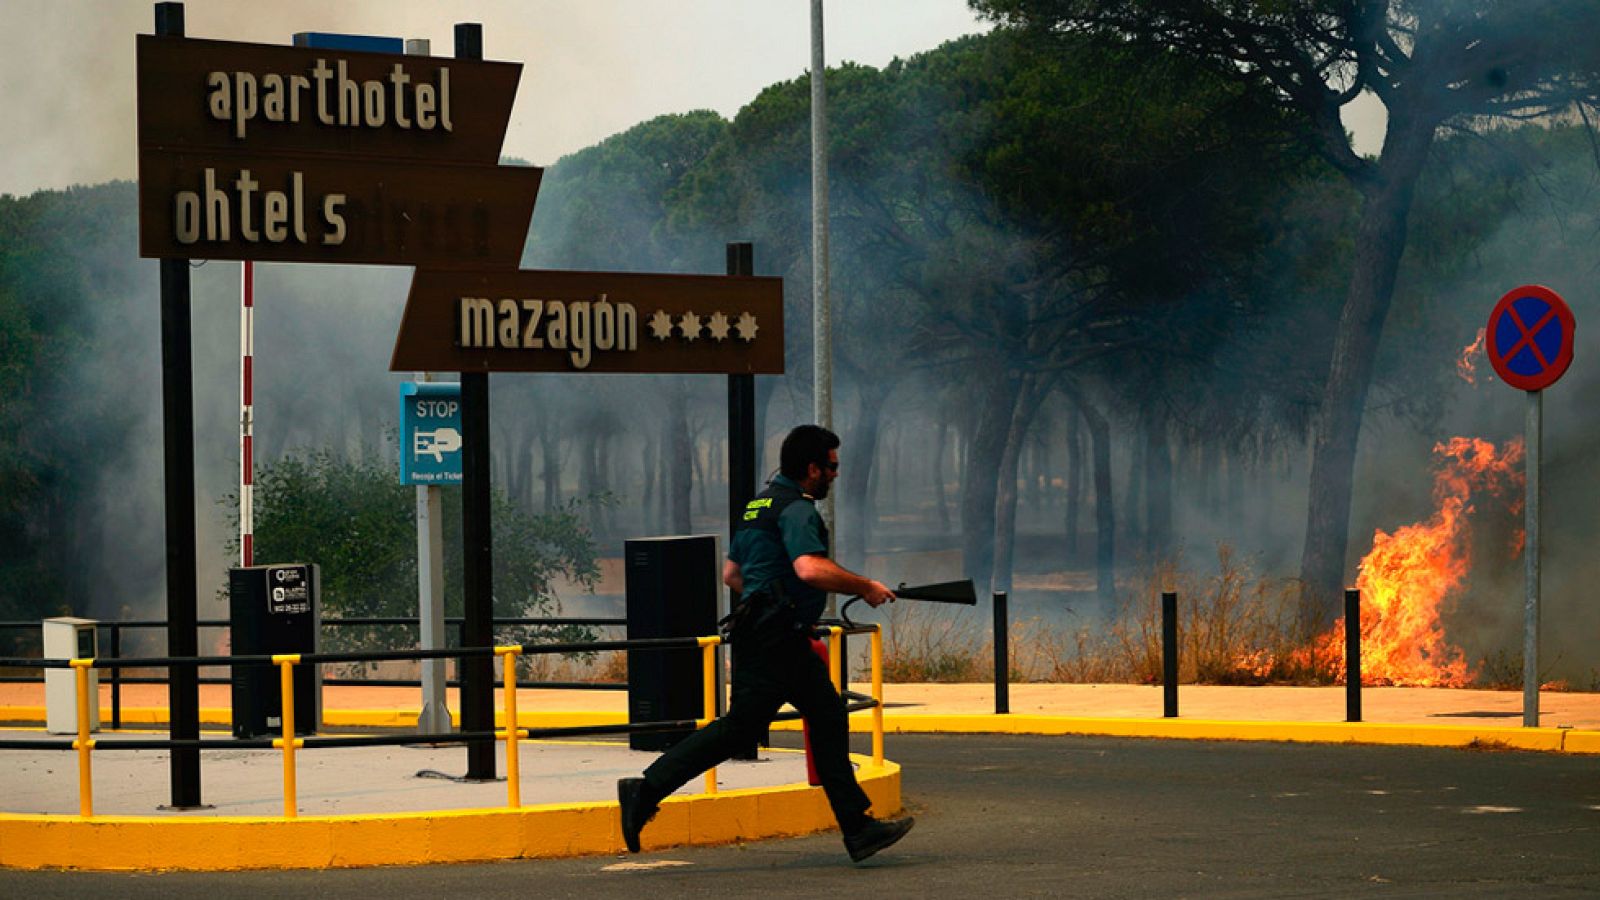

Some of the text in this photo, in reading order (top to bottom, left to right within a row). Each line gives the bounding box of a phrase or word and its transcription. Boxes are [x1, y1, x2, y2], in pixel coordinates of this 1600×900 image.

[207, 58, 453, 139] aparthotel
[460, 294, 638, 369] mazagón
[416, 401, 459, 418] STOP
